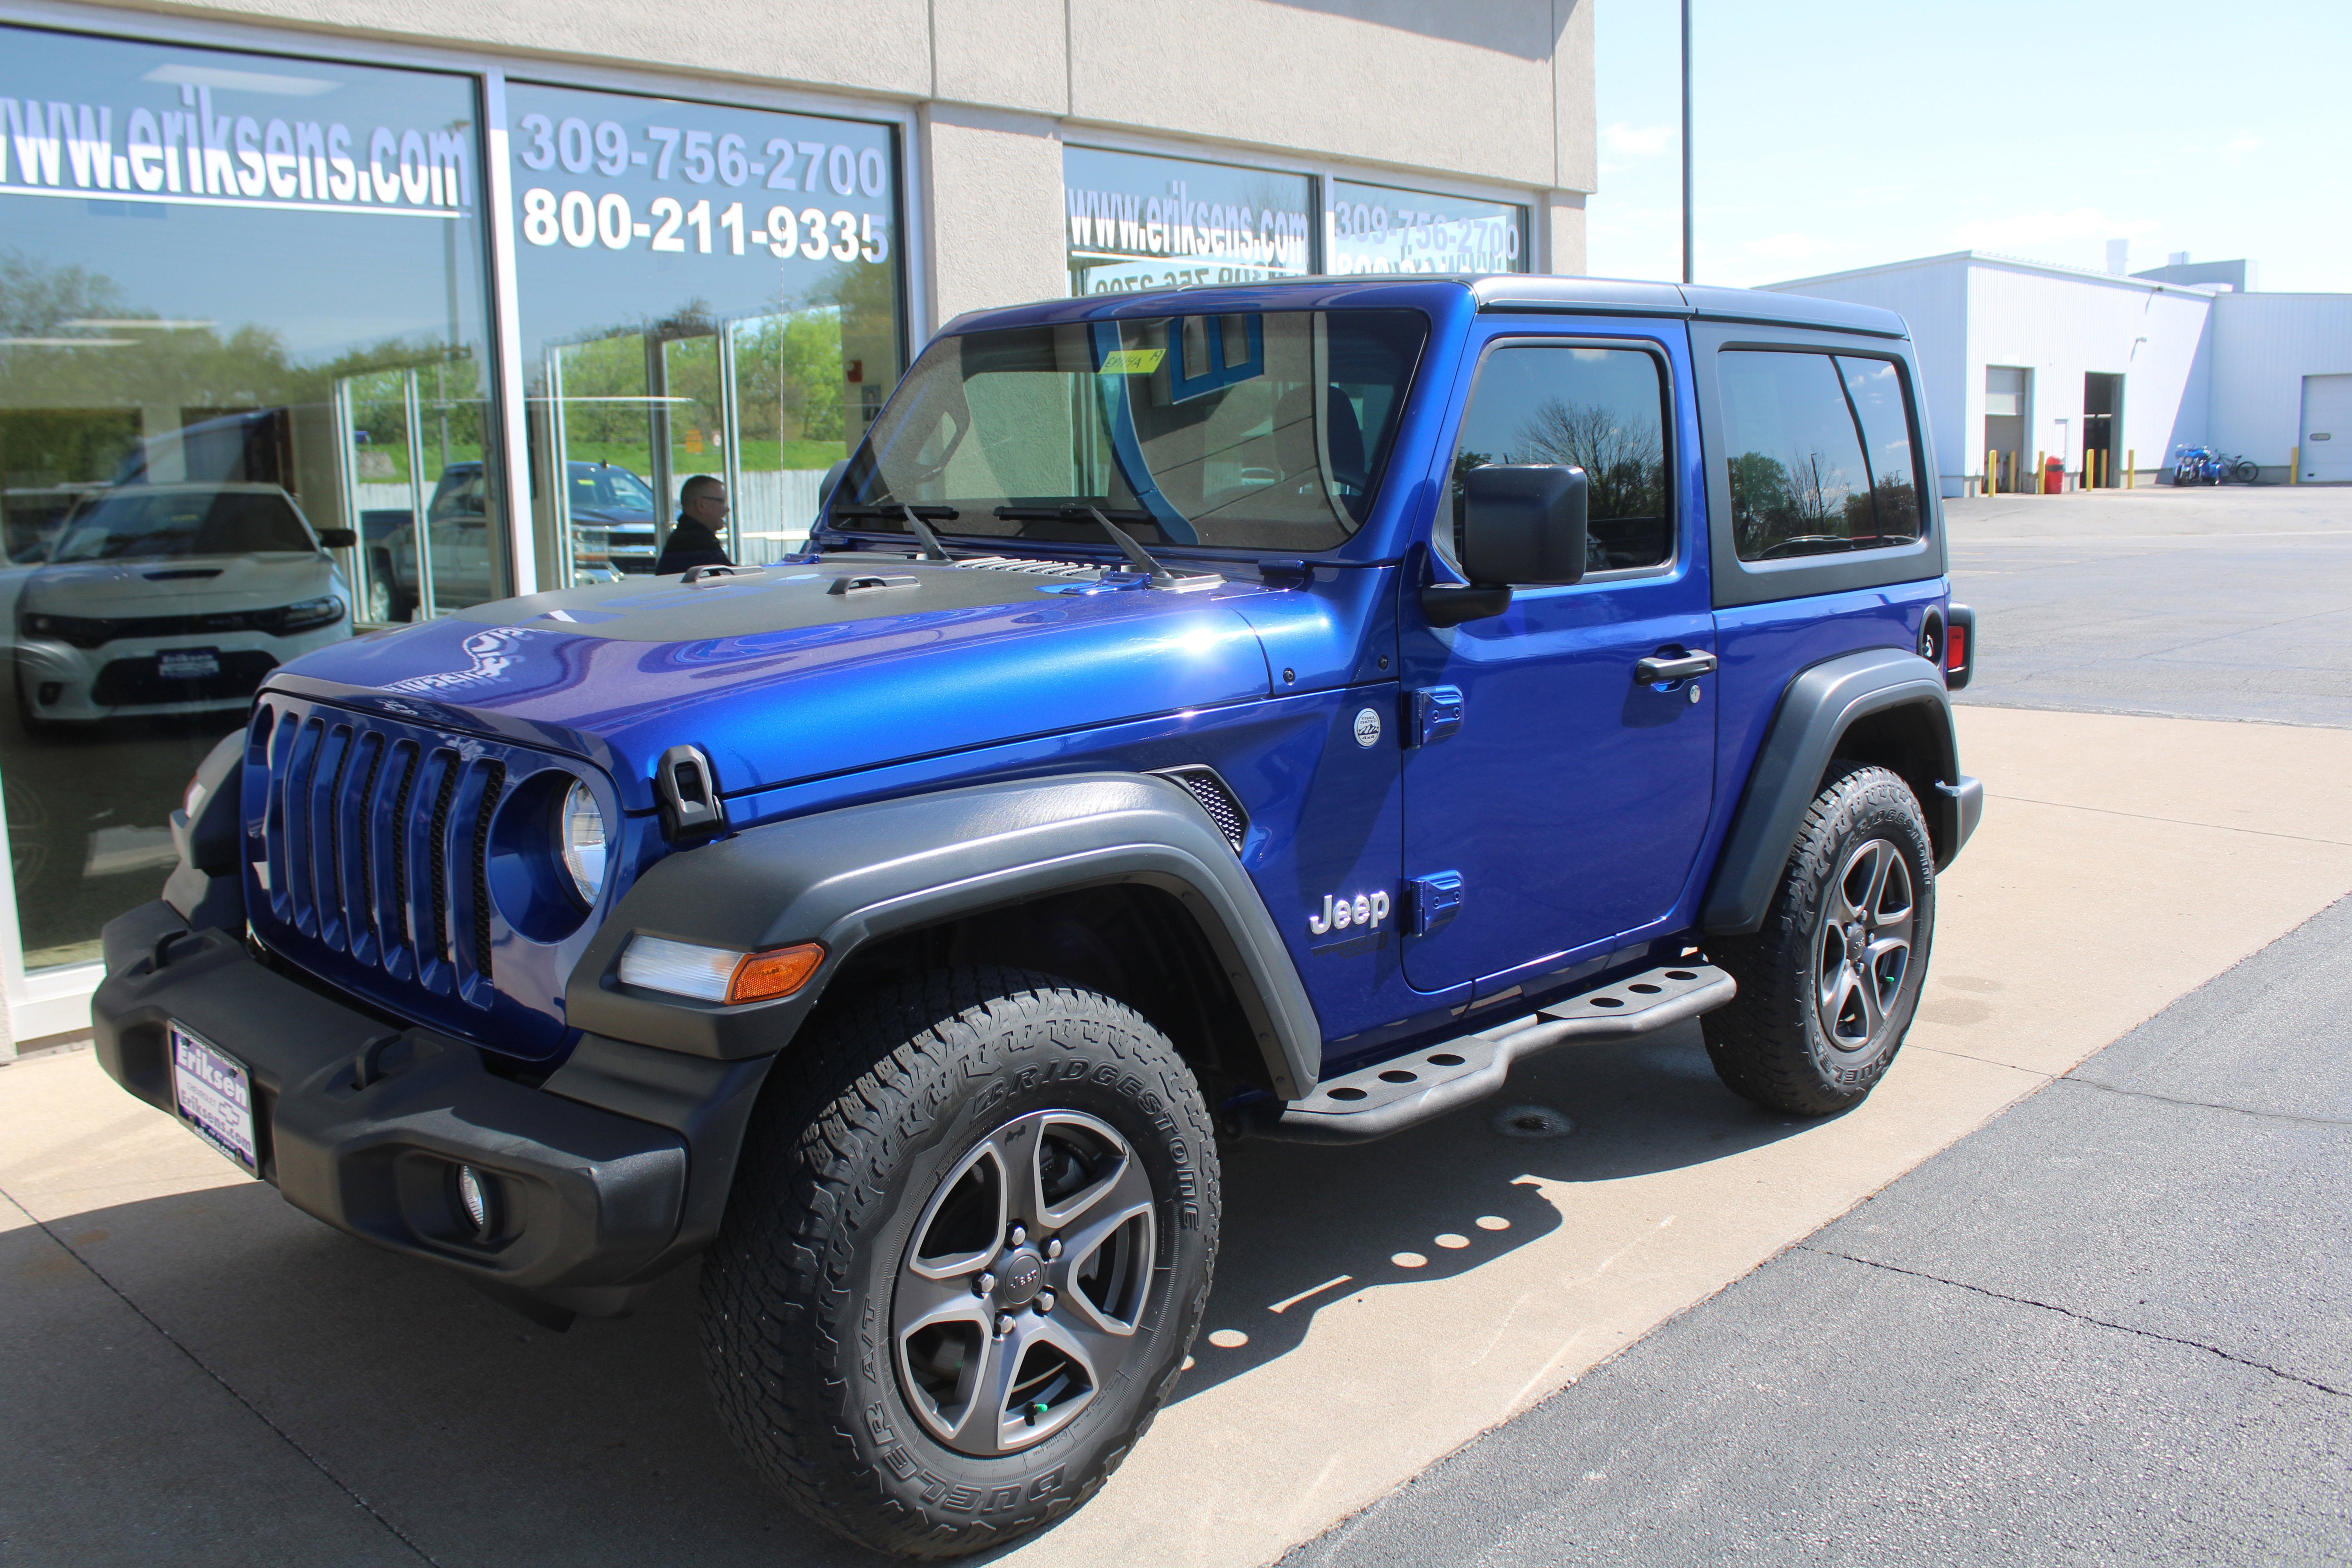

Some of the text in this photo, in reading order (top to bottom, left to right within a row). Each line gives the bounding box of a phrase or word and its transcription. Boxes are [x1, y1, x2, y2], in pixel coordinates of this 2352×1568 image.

[0, 83, 471, 207] ww.eriksens.com
[521, 113, 886, 198] 309-756-2700
[523, 188, 889, 264] 800-211-9335
[1068, 180, 1308, 264] www.eriksens.com
[1334, 201, 1519, 260] 309-756-2700
[1309, 891, 1390, 935] Jeep
[176, 1038, 248, 1108] Eriksen
[970, 1056, 1200, 1230] BRIDGESTONE
[860, 1296, 877, 1383] A/T
[864, 1400, 1066, 1512] DUELER
